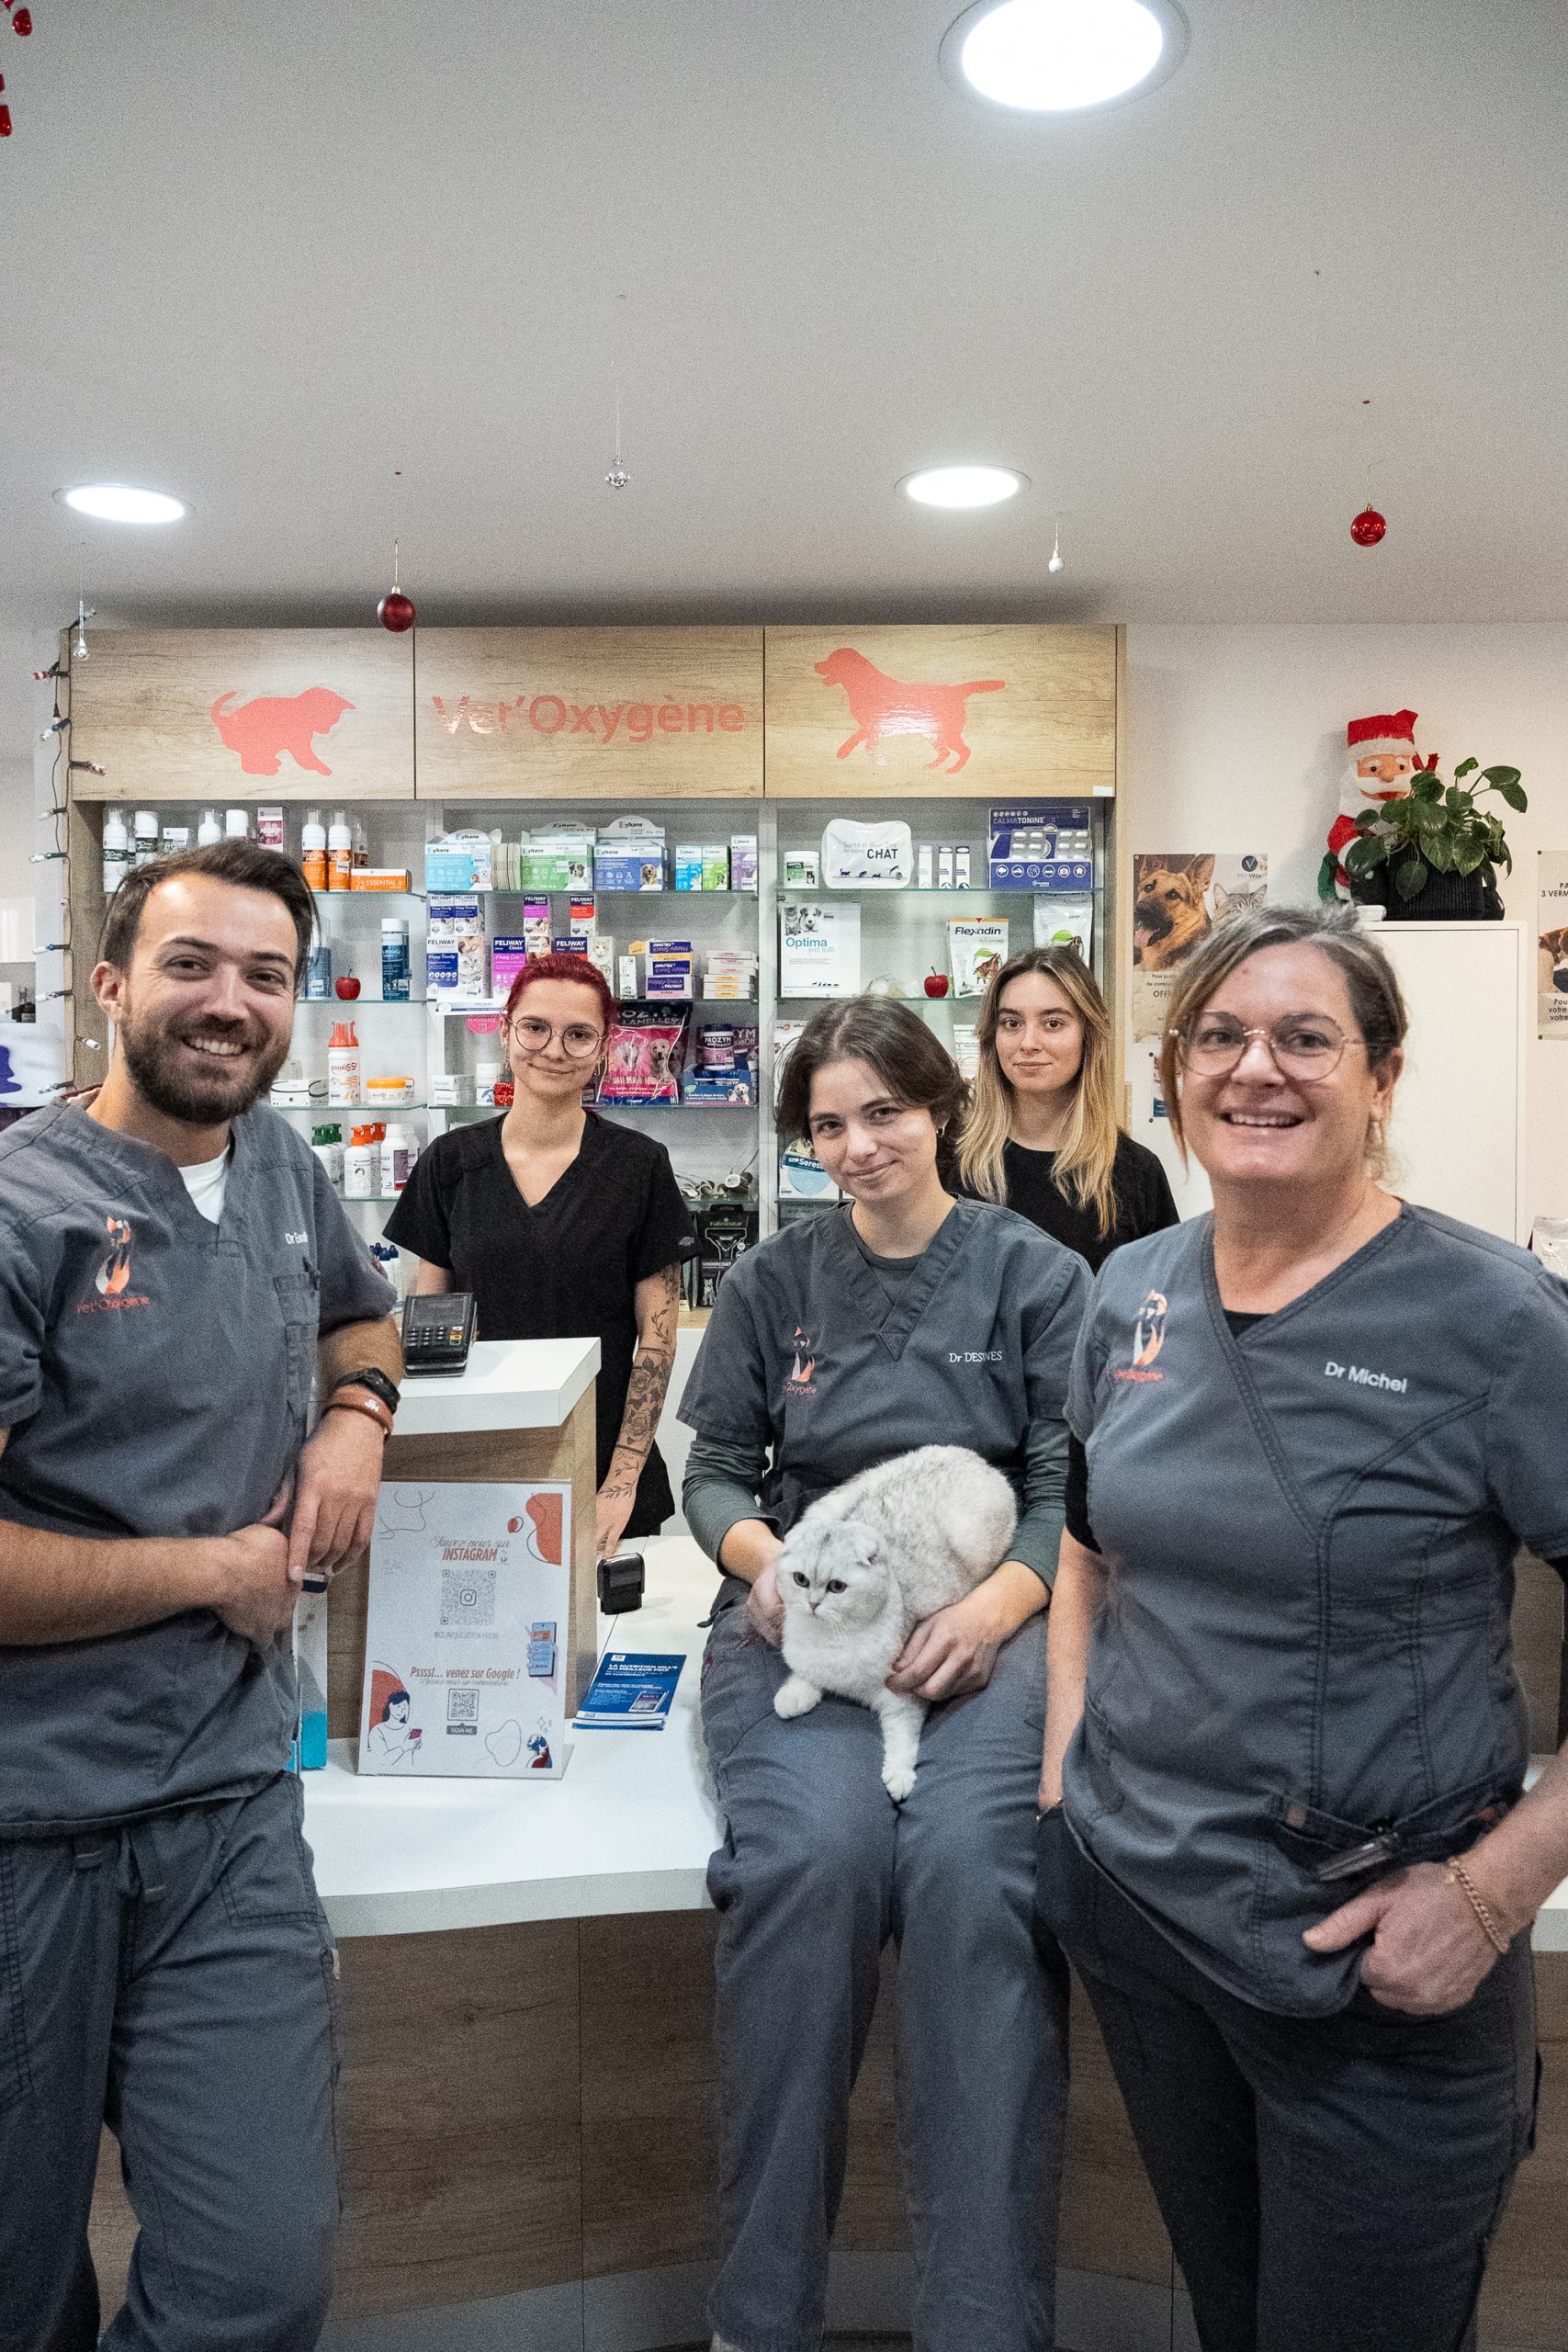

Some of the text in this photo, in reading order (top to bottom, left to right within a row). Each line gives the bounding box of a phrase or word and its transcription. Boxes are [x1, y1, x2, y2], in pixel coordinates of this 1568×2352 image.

[432, 695, 745, 742] Vet'Oxygène
[867, 849, 898, 859] CHAT
[955, 927, 1001, 935] Flexadin
[786, 937, 827, 948] Optima
[623, 1017, 677, 1025] LAMELLES
[949, 1352, 962, 1363] Dr
[1325, 1362, 1407, 1394] Dr Michel
[442, 1548, 498, 1561] INSTAGRAM
[446, 1668, 468, 1678] venez
[471, 1669, 483, 1678] sur
[486, 1668, 514, 1681] Google
